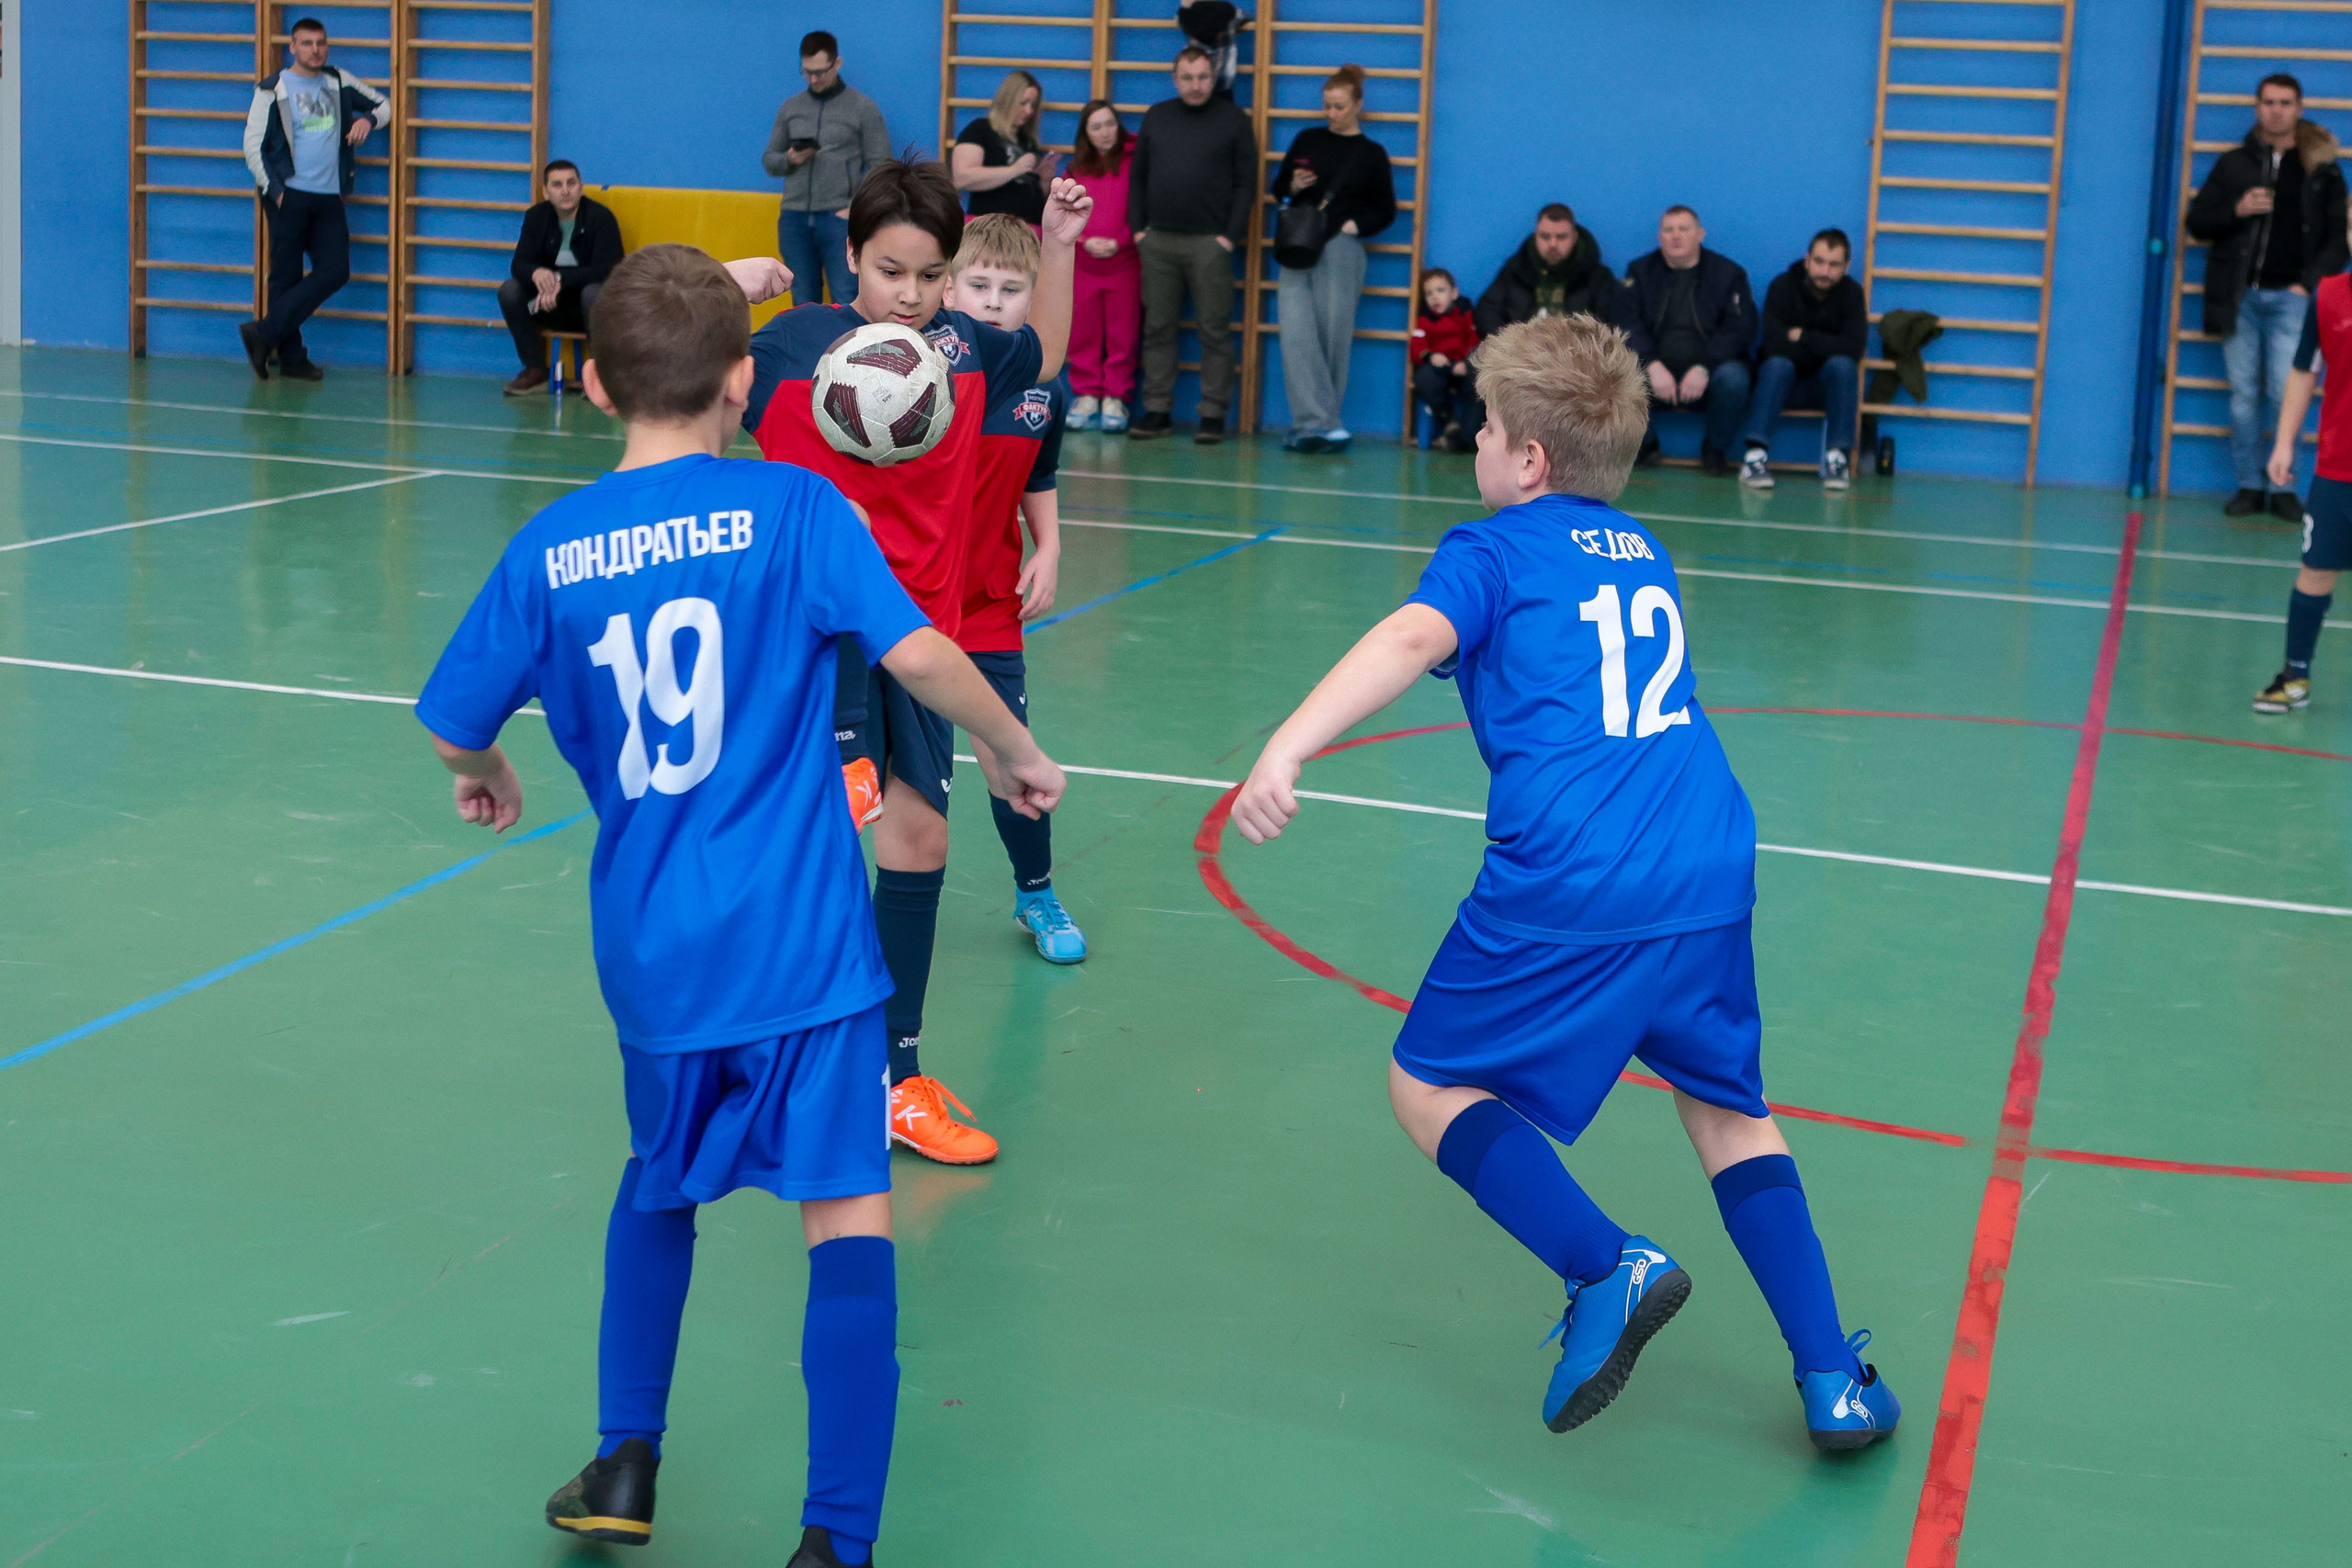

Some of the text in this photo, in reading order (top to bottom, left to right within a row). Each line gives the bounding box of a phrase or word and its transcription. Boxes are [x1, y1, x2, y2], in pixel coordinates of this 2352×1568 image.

[546, 510, 754, 590] КОНДРАТЬЕВ
[1571, 527, 1656, 561] СЕДОВ
[587, 597, 725, 801] 19
[1578, 584, 1691, 739] 12
